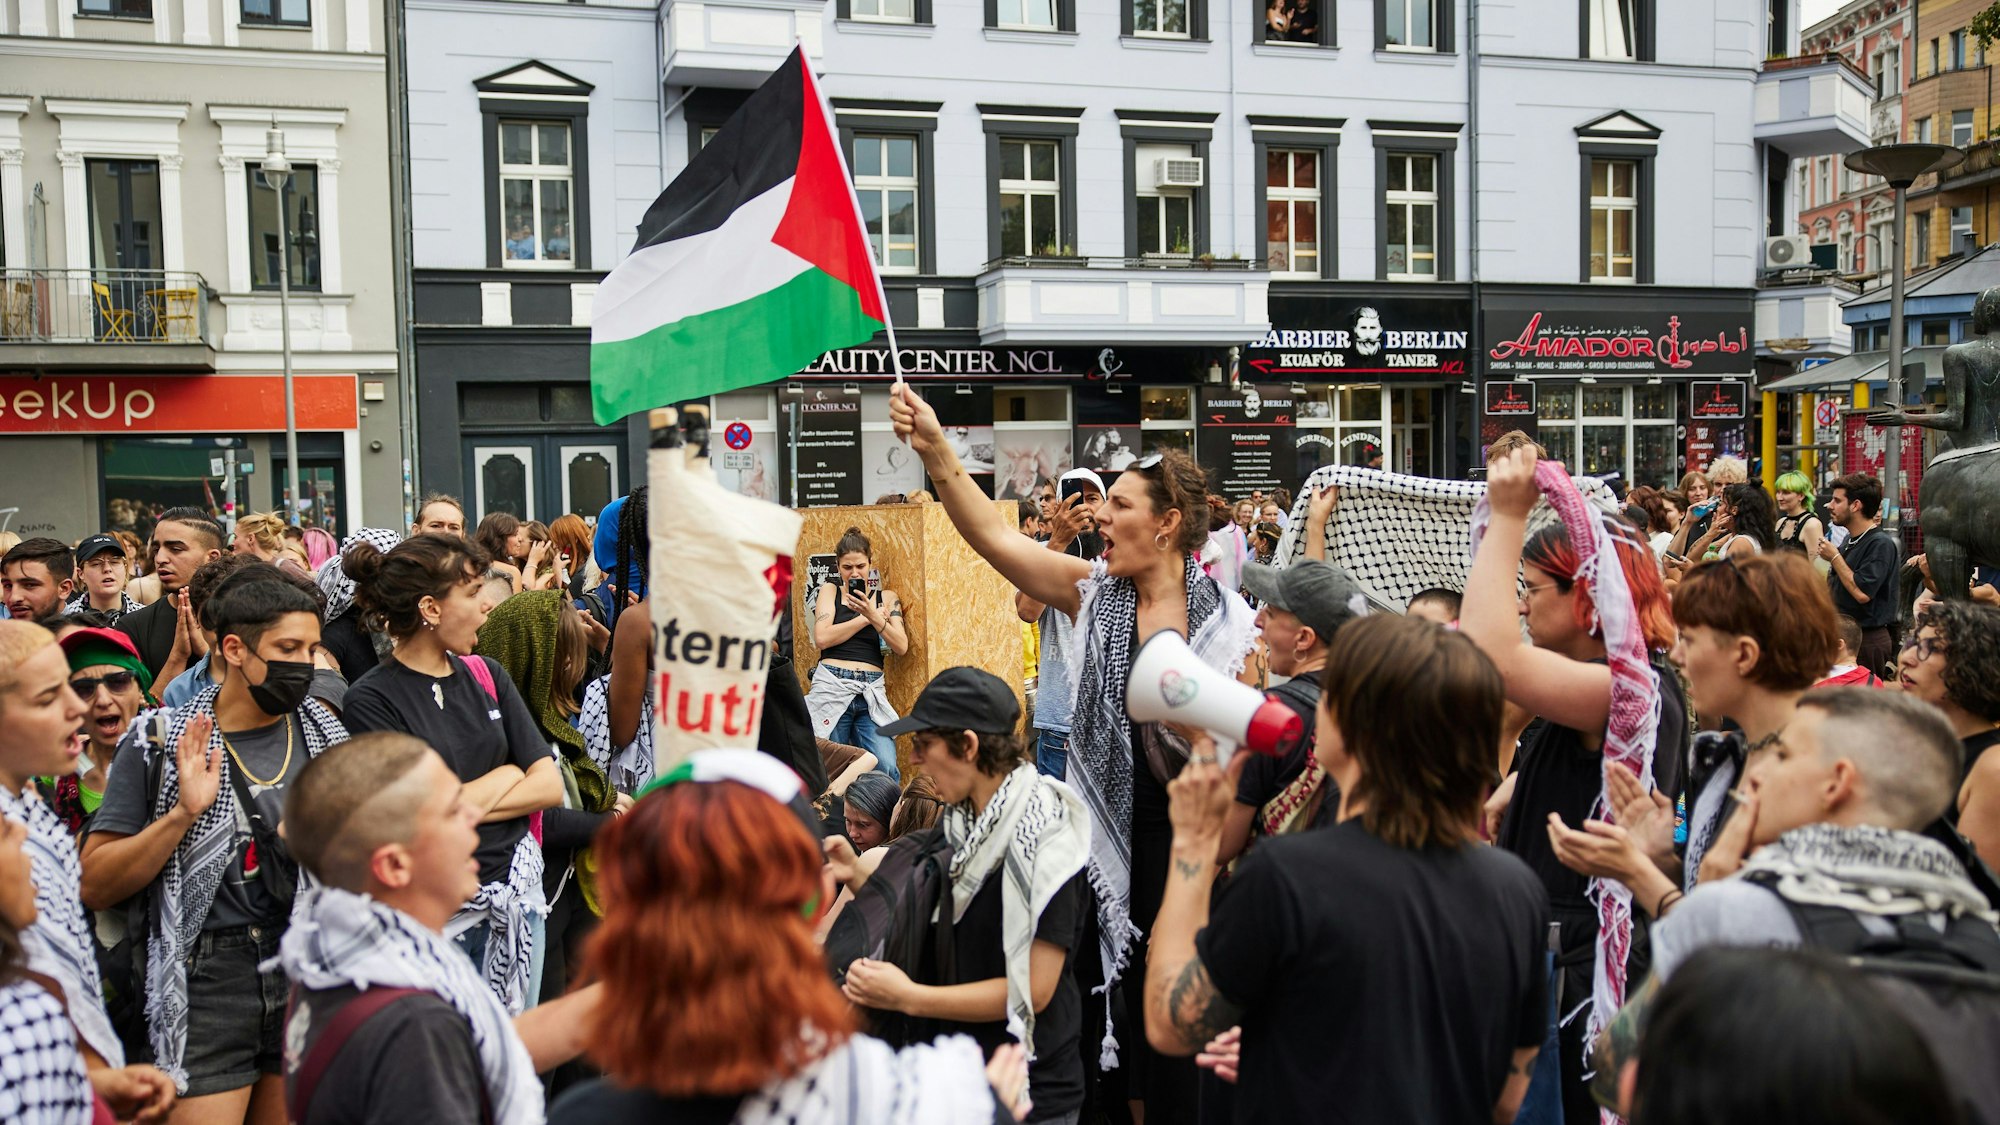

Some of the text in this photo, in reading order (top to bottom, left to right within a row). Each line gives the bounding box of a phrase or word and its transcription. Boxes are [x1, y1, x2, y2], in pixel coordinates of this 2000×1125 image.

[1386, 331, 1468, 349] BERLIN
[796, 350, 1062, 373] EAUTY CENTER NCL
[1280, 351, 1438, 367] KUAFÖR TANER
[1440, 360, 1465, 374] NCL
[782, 403, 857, 412] BETY CENTER NCL
[1208, 400, 1293, 408] BARBIER BERLIN
[1340, 432, 1381, 448] KINDER
[653, 672, 765, 736] luti
